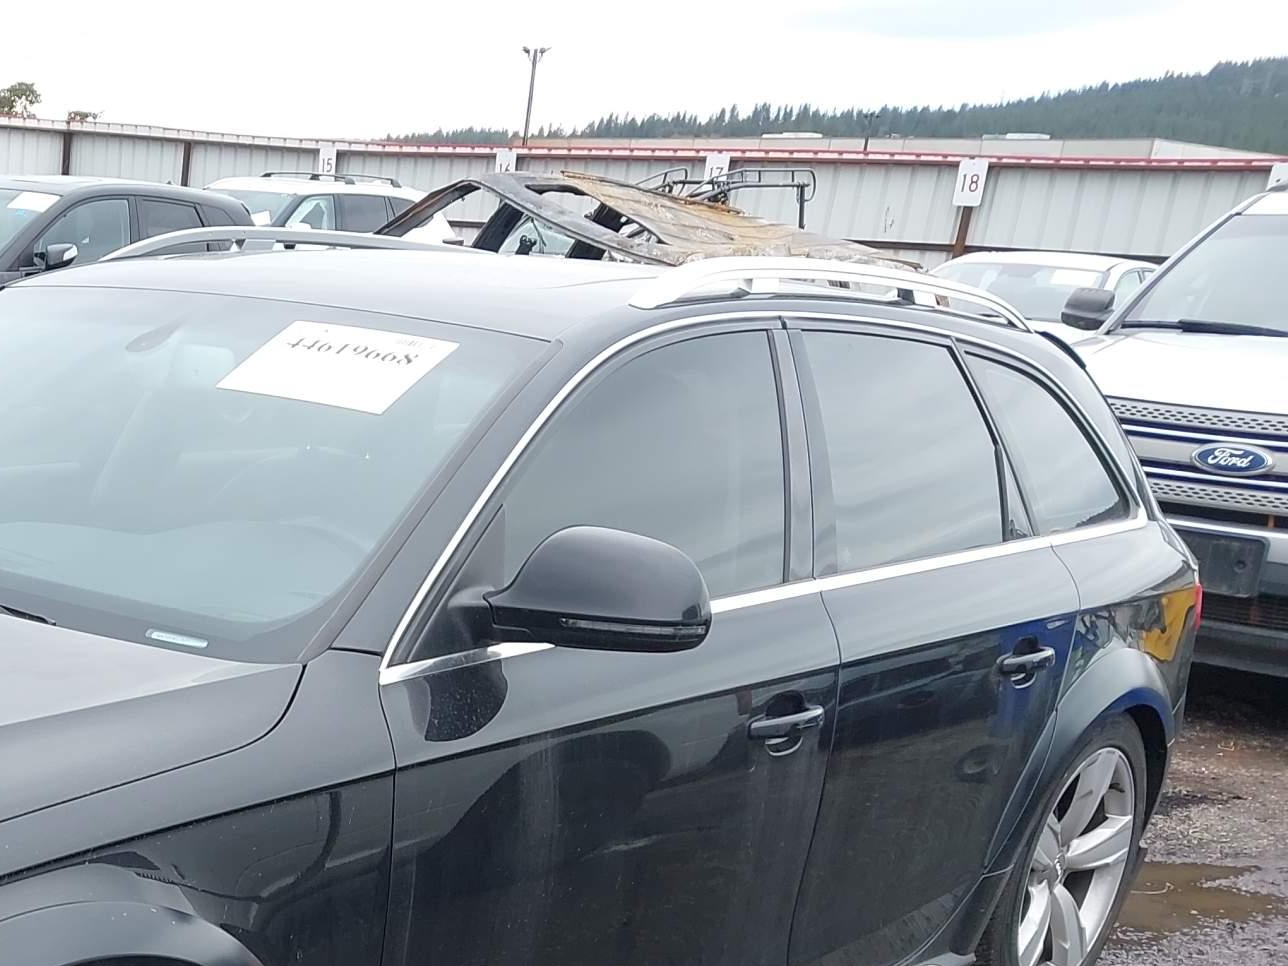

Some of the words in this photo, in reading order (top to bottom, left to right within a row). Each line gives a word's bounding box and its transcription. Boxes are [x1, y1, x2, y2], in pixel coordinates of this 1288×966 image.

[321, 157, 333, 173] 15
[960, 173, 980, 193] 18
[286, 337, 419, 365] 44619668
[1207, 447, 1255, 468] Ford
